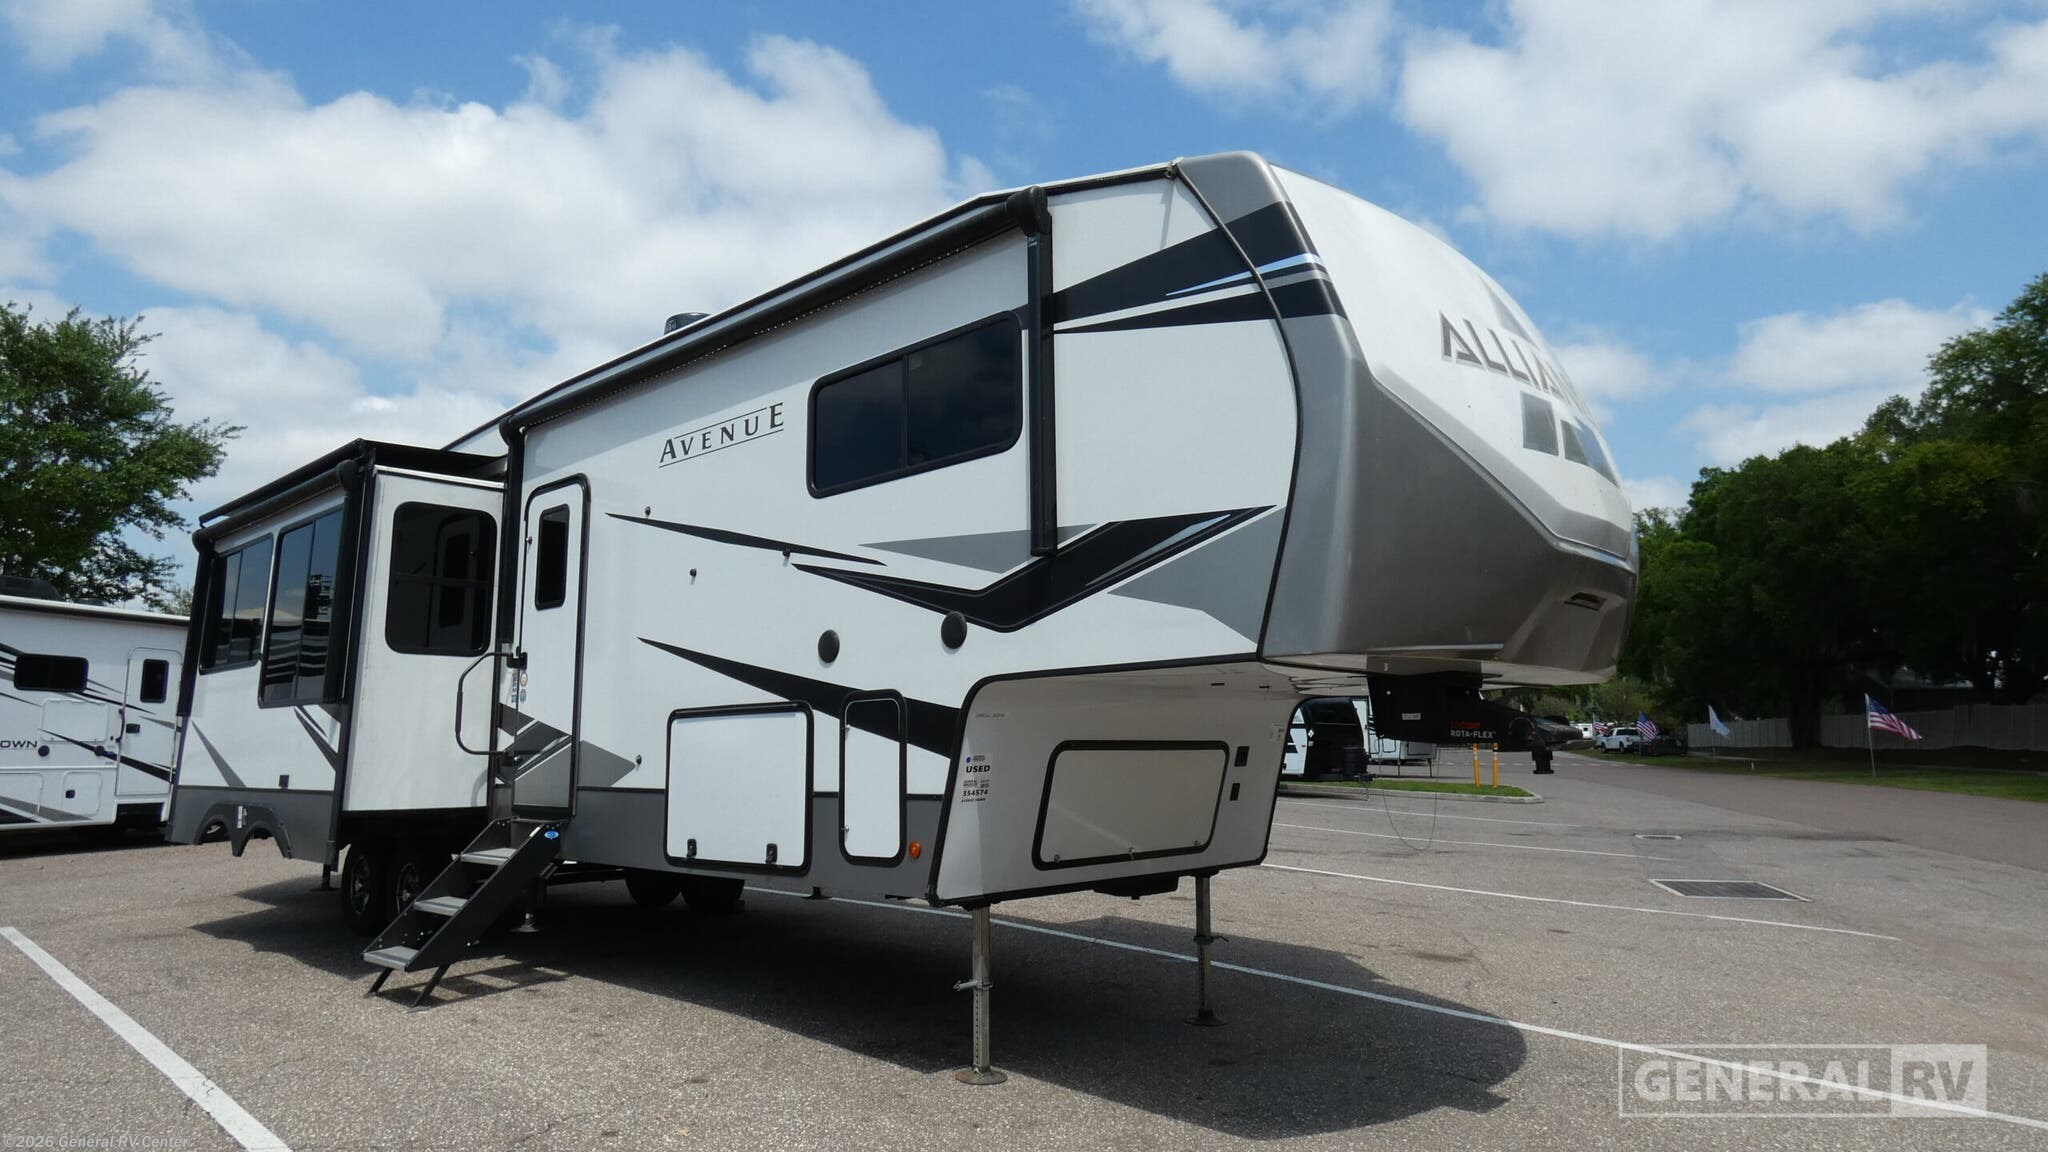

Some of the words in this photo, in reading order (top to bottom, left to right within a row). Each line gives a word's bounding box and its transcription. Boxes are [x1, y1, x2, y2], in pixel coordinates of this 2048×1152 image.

[660, 402, 784, 463] AVENUE
[1450, 729, 1494, 739] ROTA-FLEX
[966, 765, 991, 773] USED
